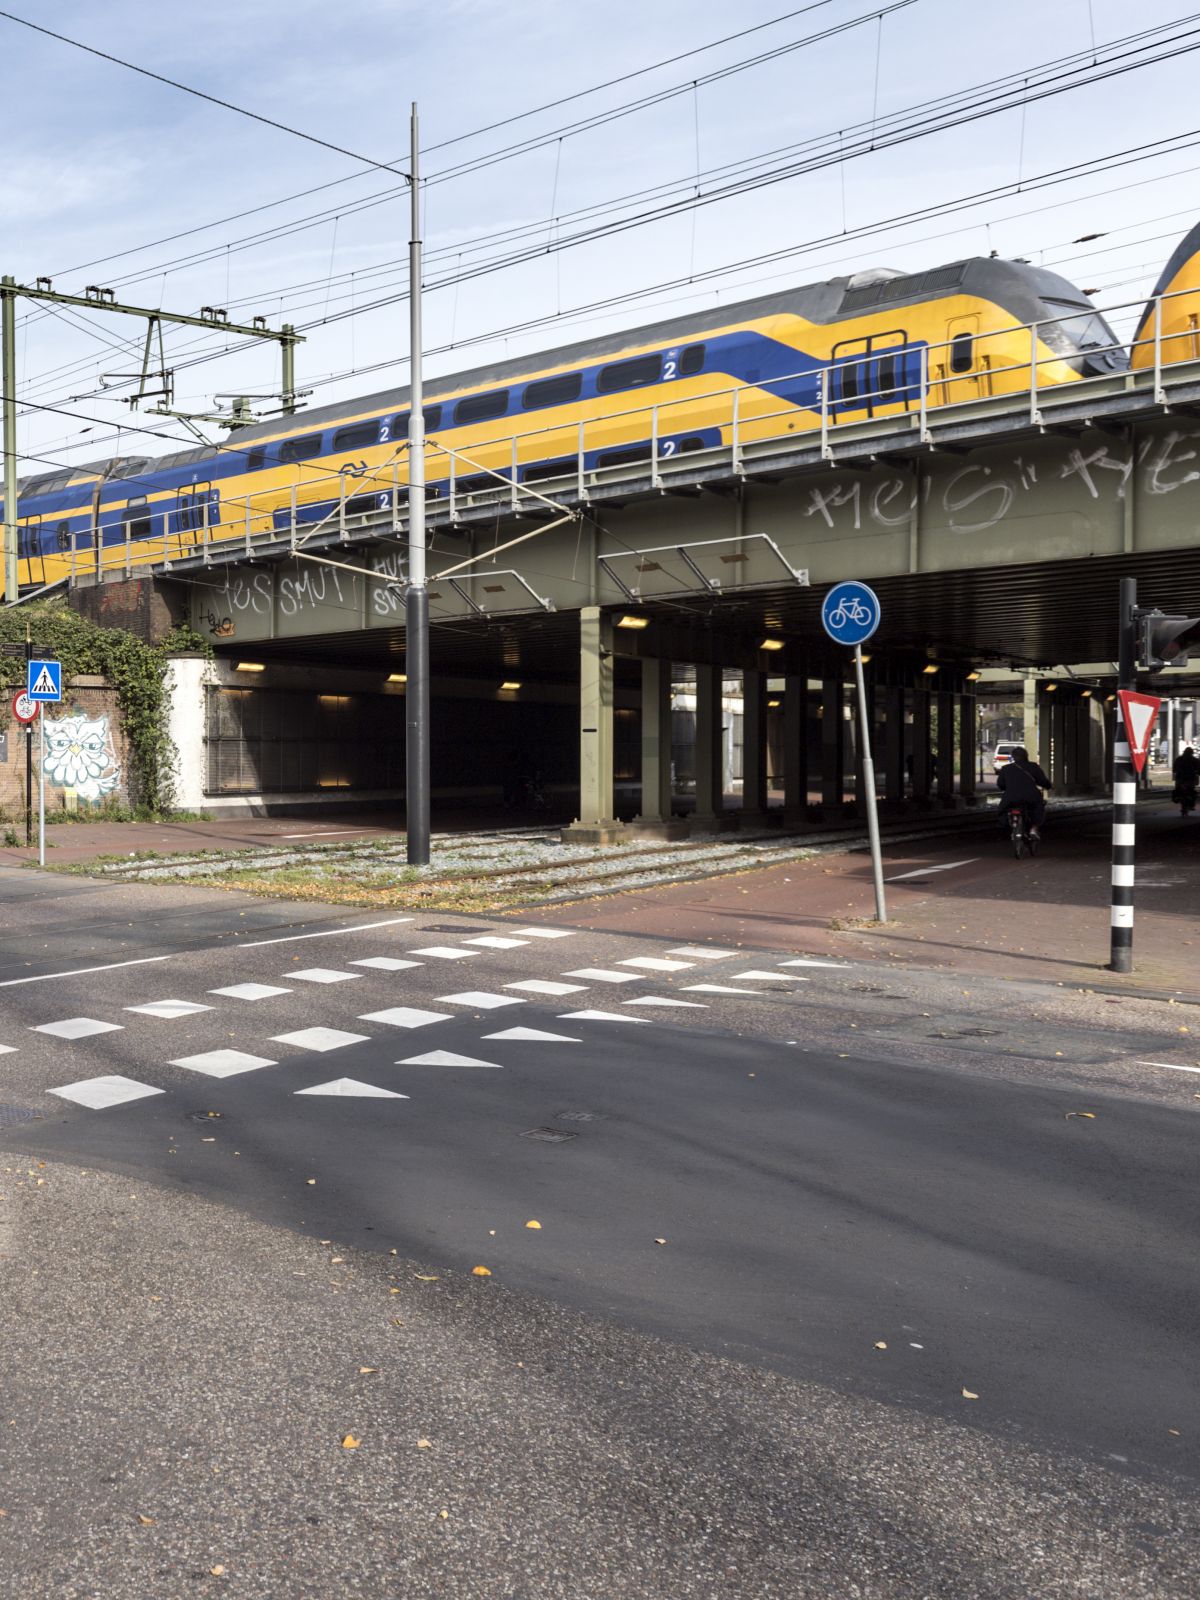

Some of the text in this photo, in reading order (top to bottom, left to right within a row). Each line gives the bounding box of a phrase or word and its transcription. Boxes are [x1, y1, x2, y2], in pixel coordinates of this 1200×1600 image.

[663, 361, 676, 380] 2
[816, 391, 823, 399] 2
[380, 426, 390, 442] 2
[663, 441, 676, 457] 2
[380, 493, 390, 509] 2
